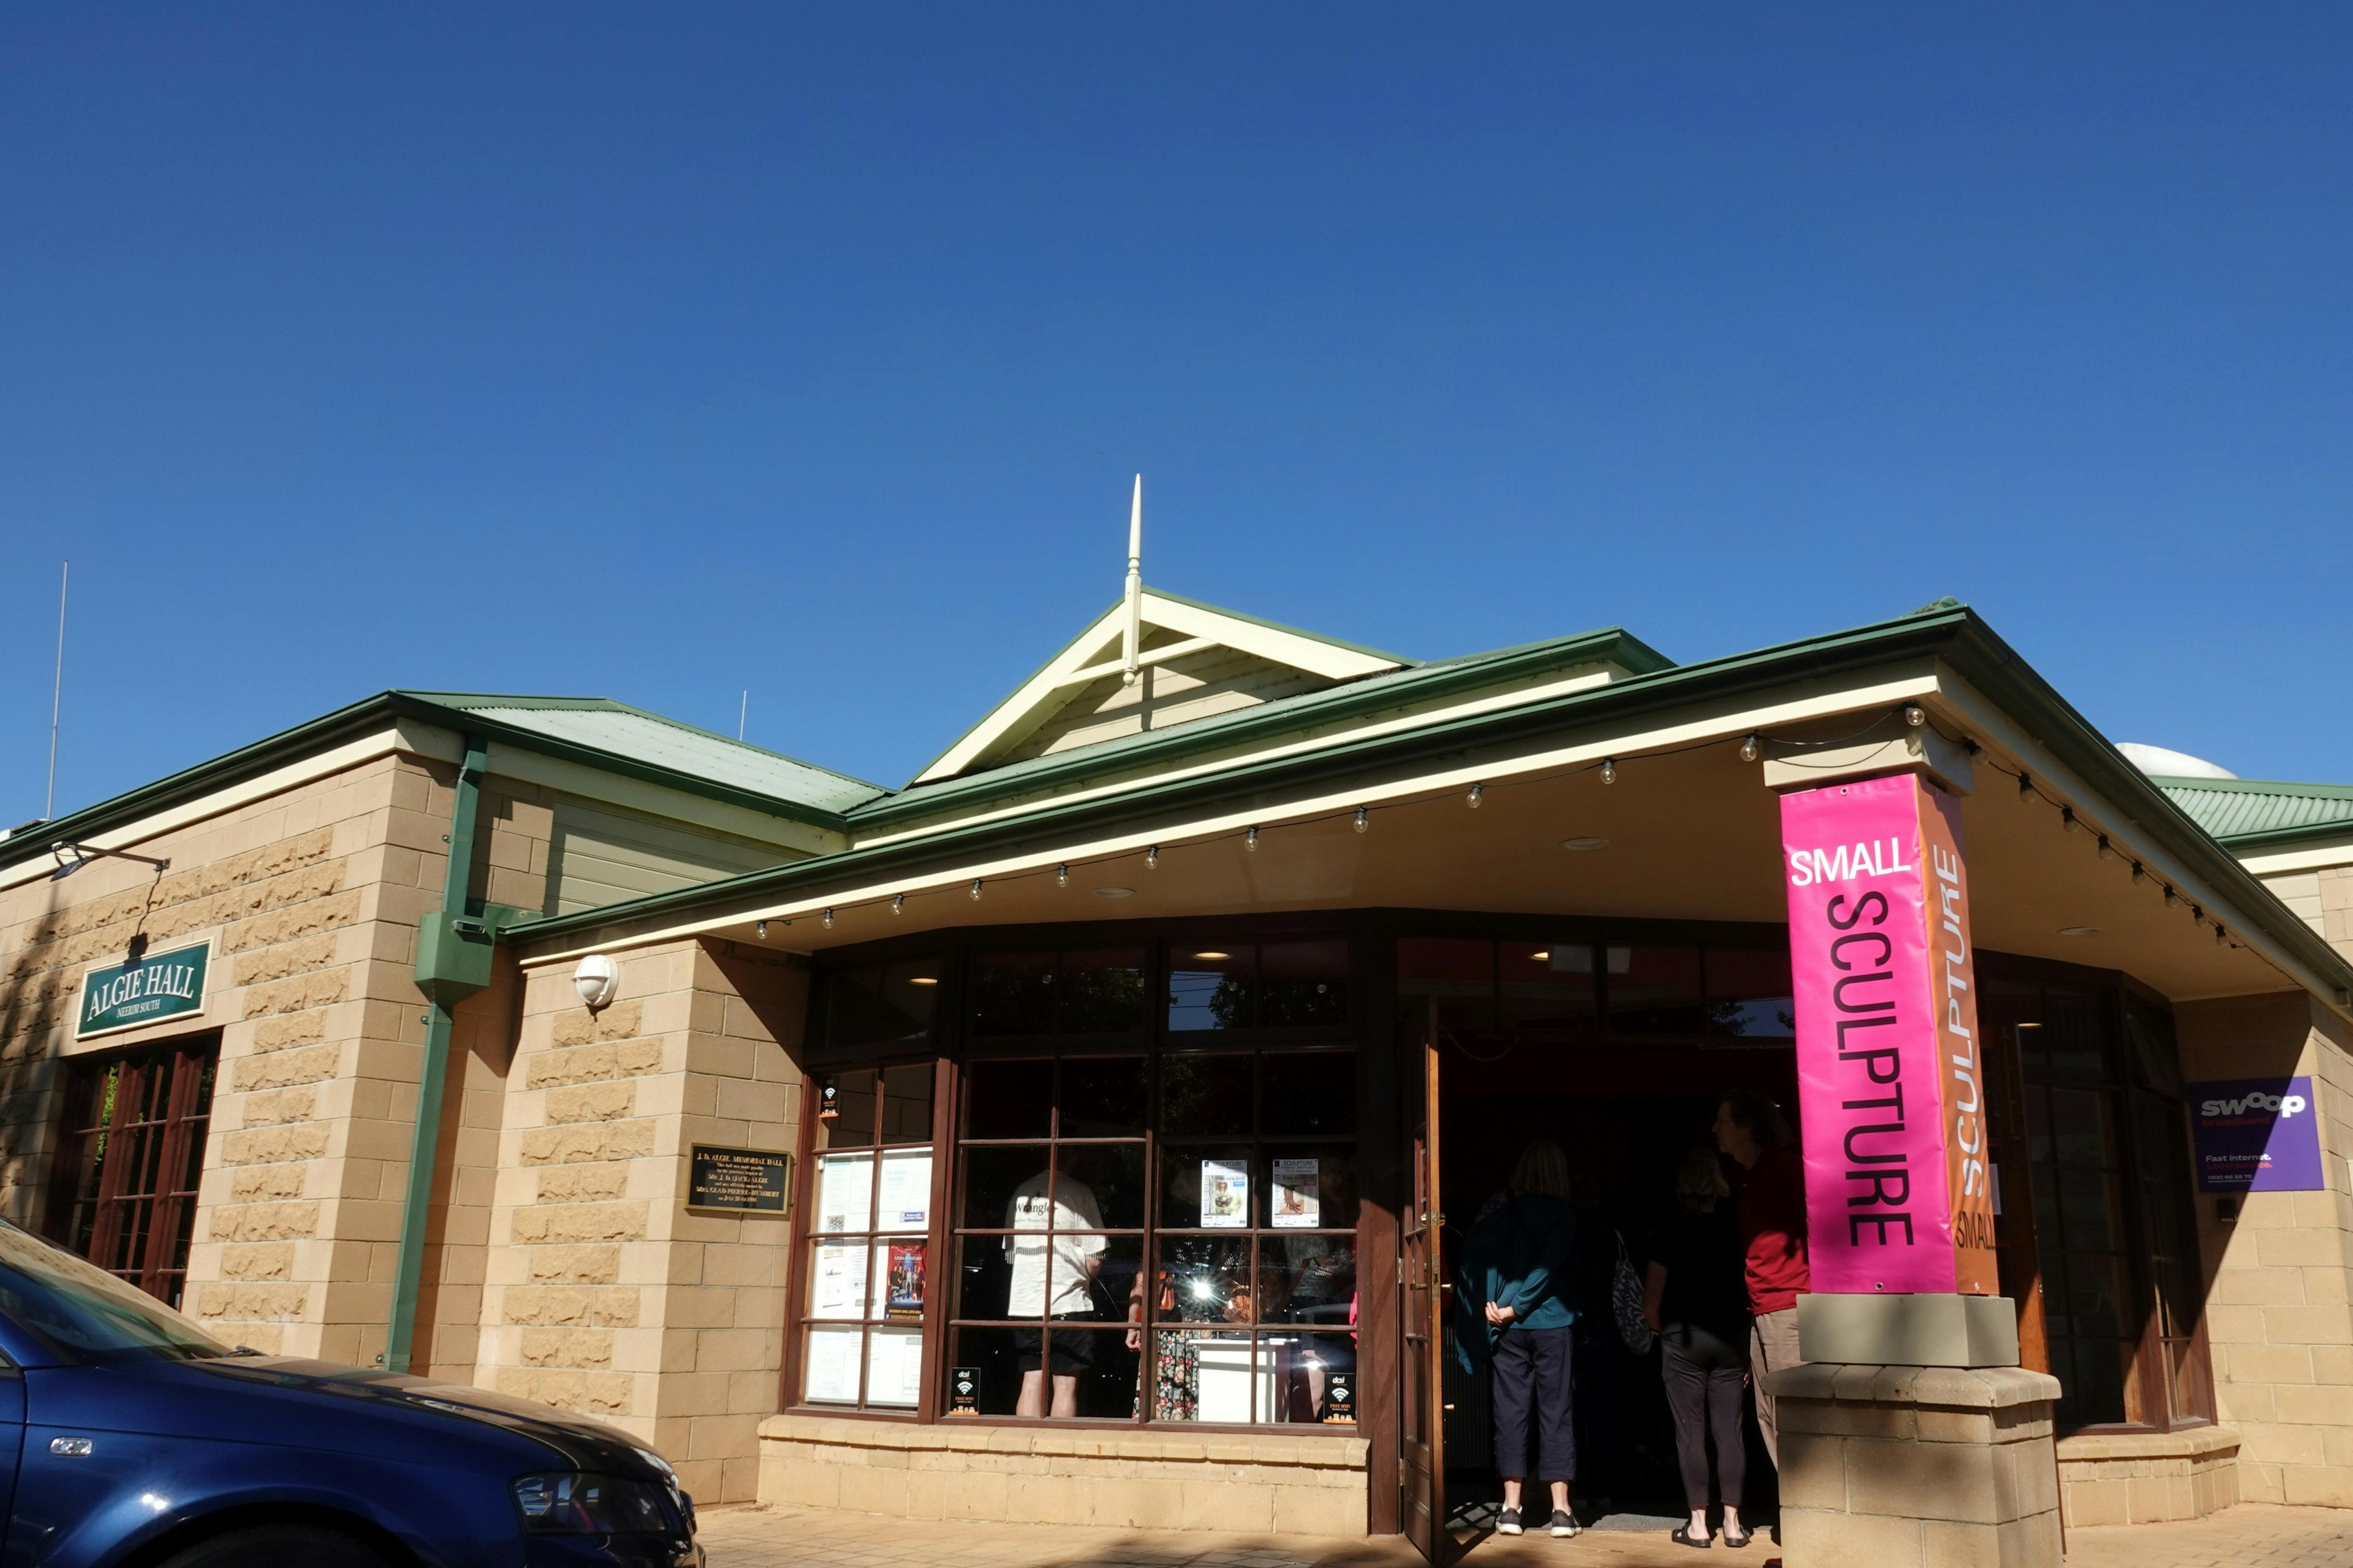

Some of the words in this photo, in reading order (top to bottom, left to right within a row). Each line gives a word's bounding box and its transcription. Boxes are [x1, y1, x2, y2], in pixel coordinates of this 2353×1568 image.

[1790, 837, 1912, 886] SMALL
[87, 969, 144, 1022] ALGIE
[144, 964, 194, 999] HALL
[116, 1003, 139, 1018] NEERIM
[139, 999, 161, 1013] SOUTH
[1934, 844, 1984, 1198] SCULPTURE
[1827, 892, 1914, 1246] SCULPTURE
[2201, 1092, 2305, 1118] swoop
[733, 1156, 766, 1165] MEMORIAL
[767, 1158, 784, 1167] HALL
[1016, 1202, 1058, 1216] Wrangl
[1956, 1211, 1995, 1250] SMALL
